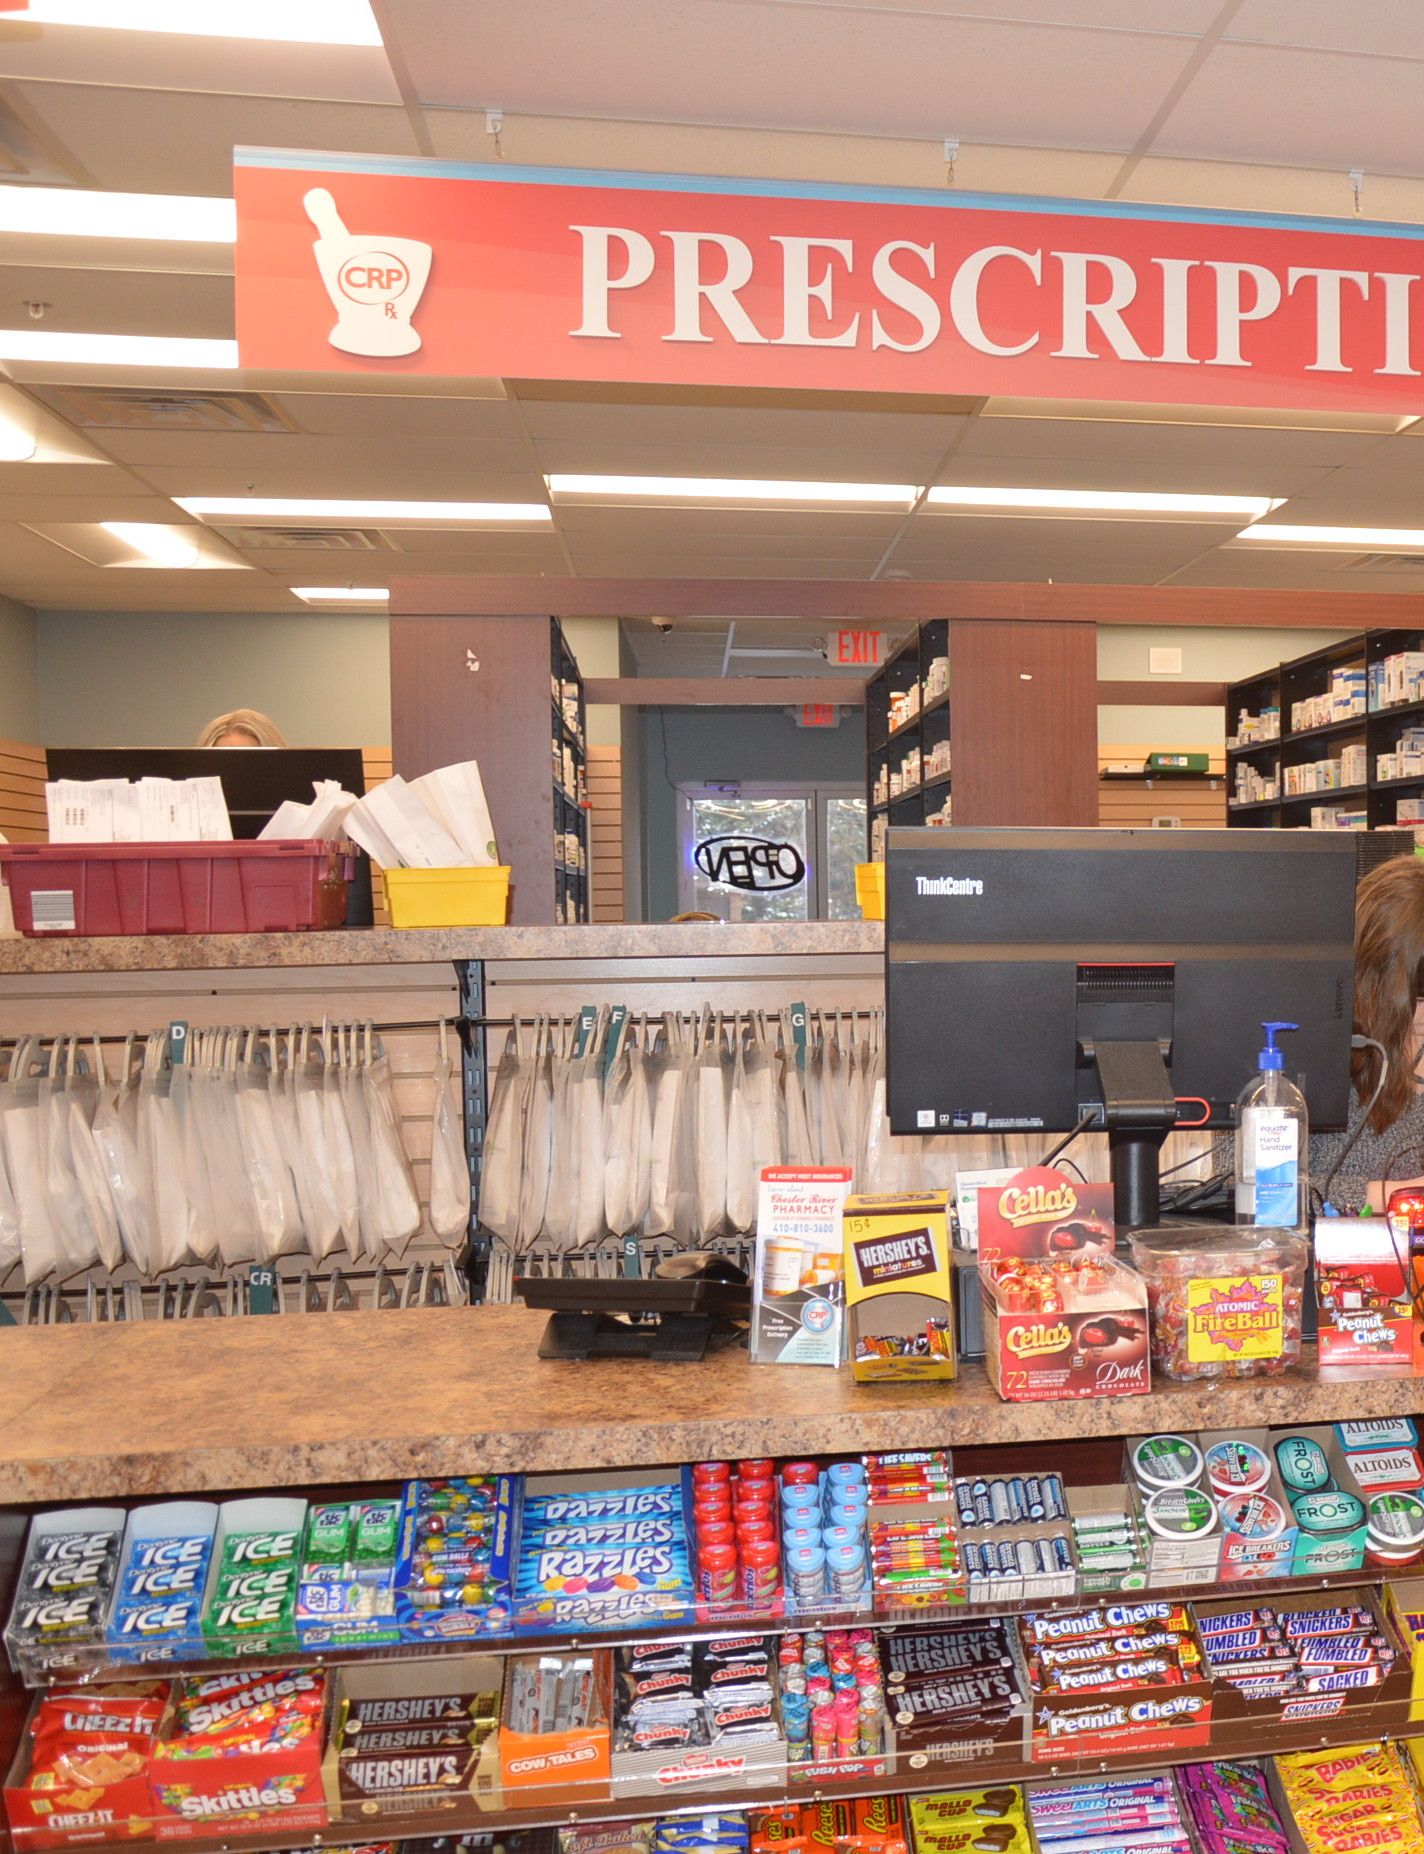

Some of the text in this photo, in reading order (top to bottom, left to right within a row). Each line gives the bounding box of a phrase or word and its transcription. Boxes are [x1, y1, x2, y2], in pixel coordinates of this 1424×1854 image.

[344, 266, 403, 290] CRP
[837, 631, 880, 663] EXIT
[802, 704, 834, 725] EXIT
[916, 876, 983, 895] ThinkCentre
[582, 1016, 593, 1030] E
[611, 1011, 624, 1024] F
[792, 1013, 805, 1027] G
[172, 1026, 186, 1040] D
[771, 1193, 837, 1204] Chester River
[998, 1183, 1078, 1220] Cella's
[773, 1205, 835, 1214] PHARMACY
[773, 1223, 834, 1233] 410-810-3600
[849, 1217, 870, 1233] 15¢
[625, 1242, 637, 1255] S
[860, 1236, 928, 1268] HERSHEY'S
[981, 1248, 1002, 1263] 72
[873, 1259, 922, 1276] miniatures
[250, 1271, 272, 1286] CR
[1260, 1279, 1277, 1289] 150
[810, 1311, 826, 1319] CRP
[1215, 1300, 1260, 1312] ATOMIC
[1193, 1310, 1280, 1333] FireBall
[1337, 1312, 1383, 1331] Peanut
[1006, 1322, 1073, 1353] Cella's
[1354, 1327, 1397, 1344] Chews
[1006, 1371, 1028, 1389] 72
[1096, 1359, 1144, 1385] Dark
[1346, 1418, 1404, 1435] ALTOIDS
[1292, 1441, 1316, 1486] FROST
[1353, 1457, 1412, 1474] ALTOIDS
[546, 1492, 672, 1520] Razzles
[1296, 1502, 1358, 1519] FROST
[319, 1519, 342, 1527] tac
[325, 1511, 343, 1520] tic
[366, 1518, 386, 1526] tac
[371, 1511, 388, 1520] tic
[314, 1528, 345, 1538] GUM
[361, 1526, 391, 1537] GUM
[45, 1532, 114, 1561] ICE
[142, 1537, 208, 1566] ICE
[232, 1532, 298, 1562] ICE
[1229, 1540, 1291, 1556] ICE BREAKERS
[1305, 1548, 1357, 1563] FROST
[33, 1559, 104, 1589] ICE
[538, 1547, 672, 1584] Razzles
[131, 1564, 200, 1595] ICE
[226, 1568, 293, 1598] ICE
[319, 1572, 334, 1580] tic
[21, 1596, 96, 1629] ICE
[120, 1602, 162, 1615] Dentyne
[123, 1602, 193, 1633] ICE
[217, 1595, 285, 1627] ICE
[556, 1594, 657, 1624] Razzles
[794, 1606, 837, 1614] mentos
[1033, 1602, 1171, 1640] Peanut Chews
[1200, 1612, 1252, 1633] NICKERS
[1289, 1615, 1351, 1635] SNICKERS
[235, 1641, 270, 1655] ICE
[1040, 1633, 1179, 1665] Peanut Chews
[1205, 1631, 1258, 1652] UMBLED
[42, 1654, 76, 1670] ICE
[140, 1648, 174, 1662] ICE
[890, 1641, 1002, 1672] HERSHEY'S
[1305, 1649, 1368, 1661] FUMBLED
[711, 1664, 767, 1682] Chunky
[1059, 1659, 1167, 1690] Peanut Chews
[1318, 1670, 1369, 1692] SACKED
[637, 1674, 691, 1694] Chunky
[895, 1675, 1011, 1713] HERSHEY'S
[188, 1674, 316, 1733] Skittles
[357, 1697, 462, 1722] HERSHEY'S
[1058, 1703, 1112, 1715] Goldenberg's
[715, 1704, 771, 1725] Chunky
[1050, 1697, 1201, 1736] Peanut Chews
[353, 1728, 460, 1750] HERSHEY'S
[634, 1729, 690, 1743] Chunky
[925, 1738, 995, 1760] HERSHEY'S
[509, 1748, 595, 1774] COW TALES
[840, 1764, 864, 1775] POP
[350, 1756, 458, 1789] HERSHEY'S
[180, 1786, 297, 1819] Skittles
[925, 1799, 972, 1811] MALLO
[1109, 1795, 1156, 1807] ORIGINAL
[938, 1807, 966, 1817] CUP
[924, 1833, 971, 1845] MALLO
[937, 1841, 966, 1851] CUP
[1333, 1826, 1403, 1852] BABIES
